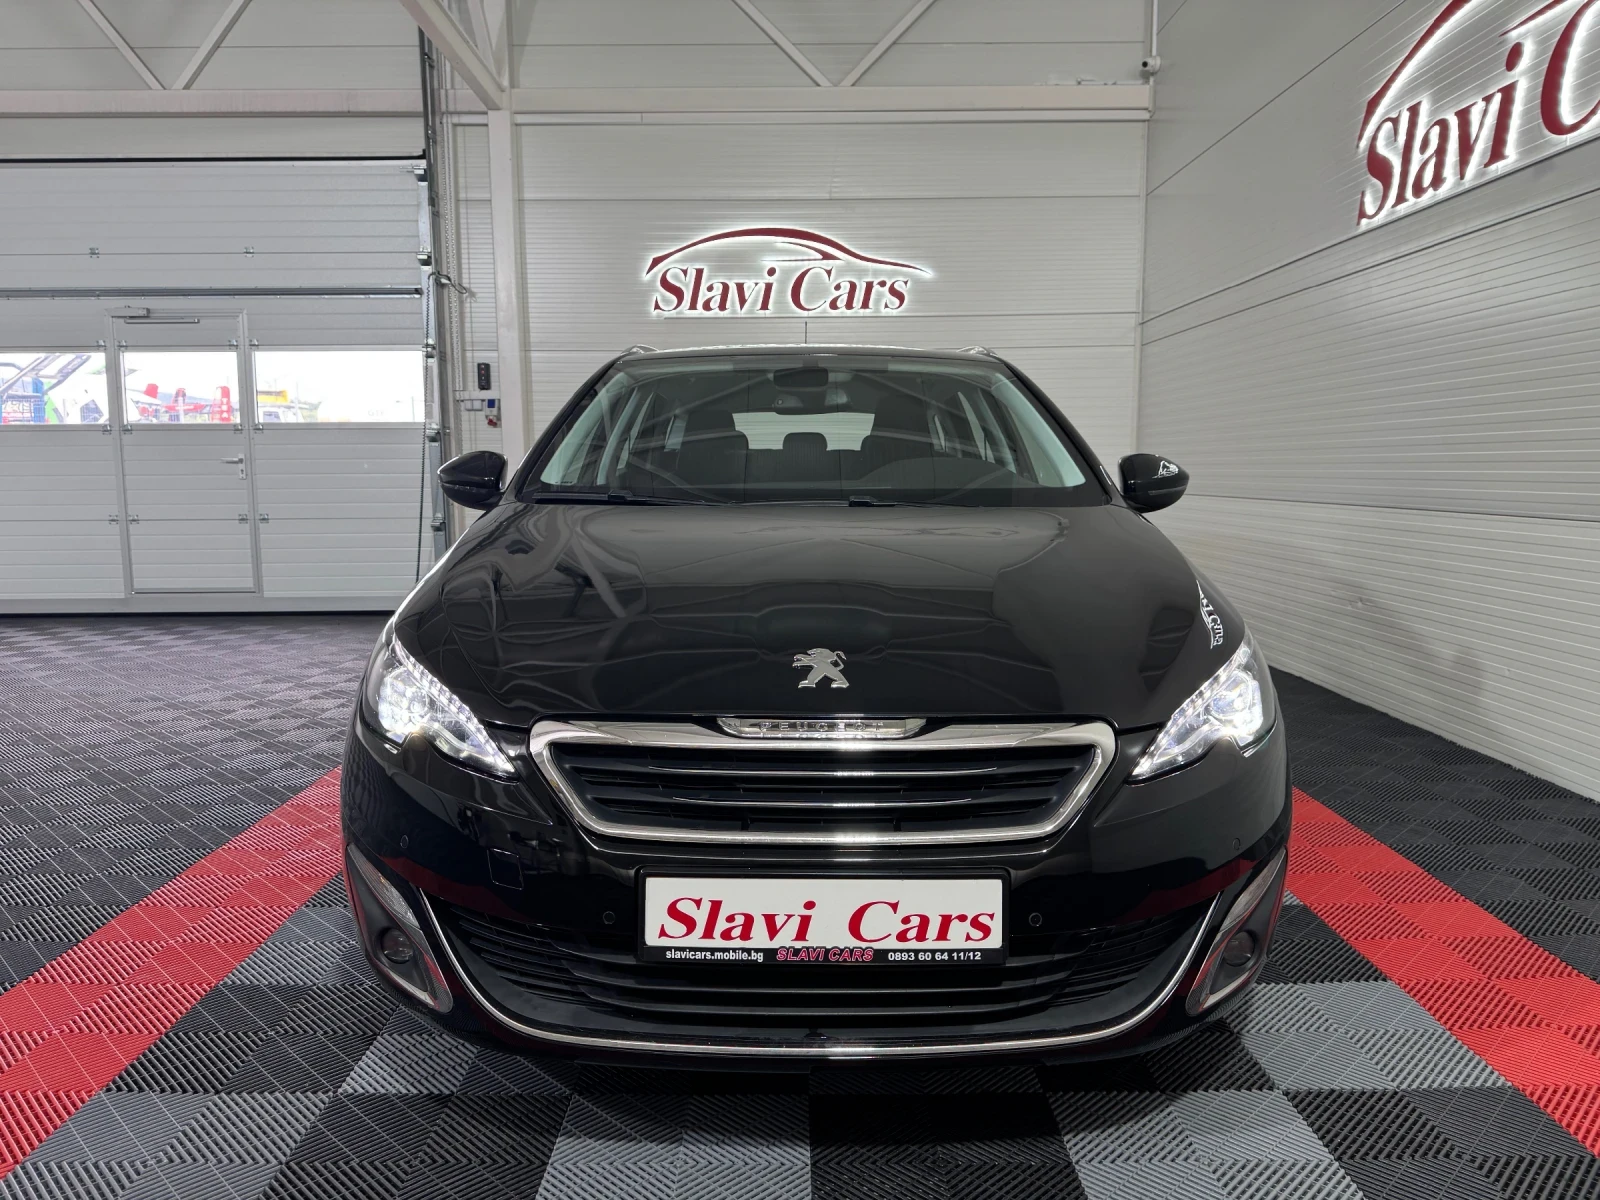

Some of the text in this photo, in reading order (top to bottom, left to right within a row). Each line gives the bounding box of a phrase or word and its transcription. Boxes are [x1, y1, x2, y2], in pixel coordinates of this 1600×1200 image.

[1356, 42, 1523, 226] Slavi
[653, 266, 909, 312] Slavi Cars
[657, 896, 996, 944] Slavi Cars
[665, 948, 764, 962] slavicars.mobile.bg
[776, 947, 875, 962] SLAVI CARS
[887, 951, 982, 961] 0893 60 64 11/12
